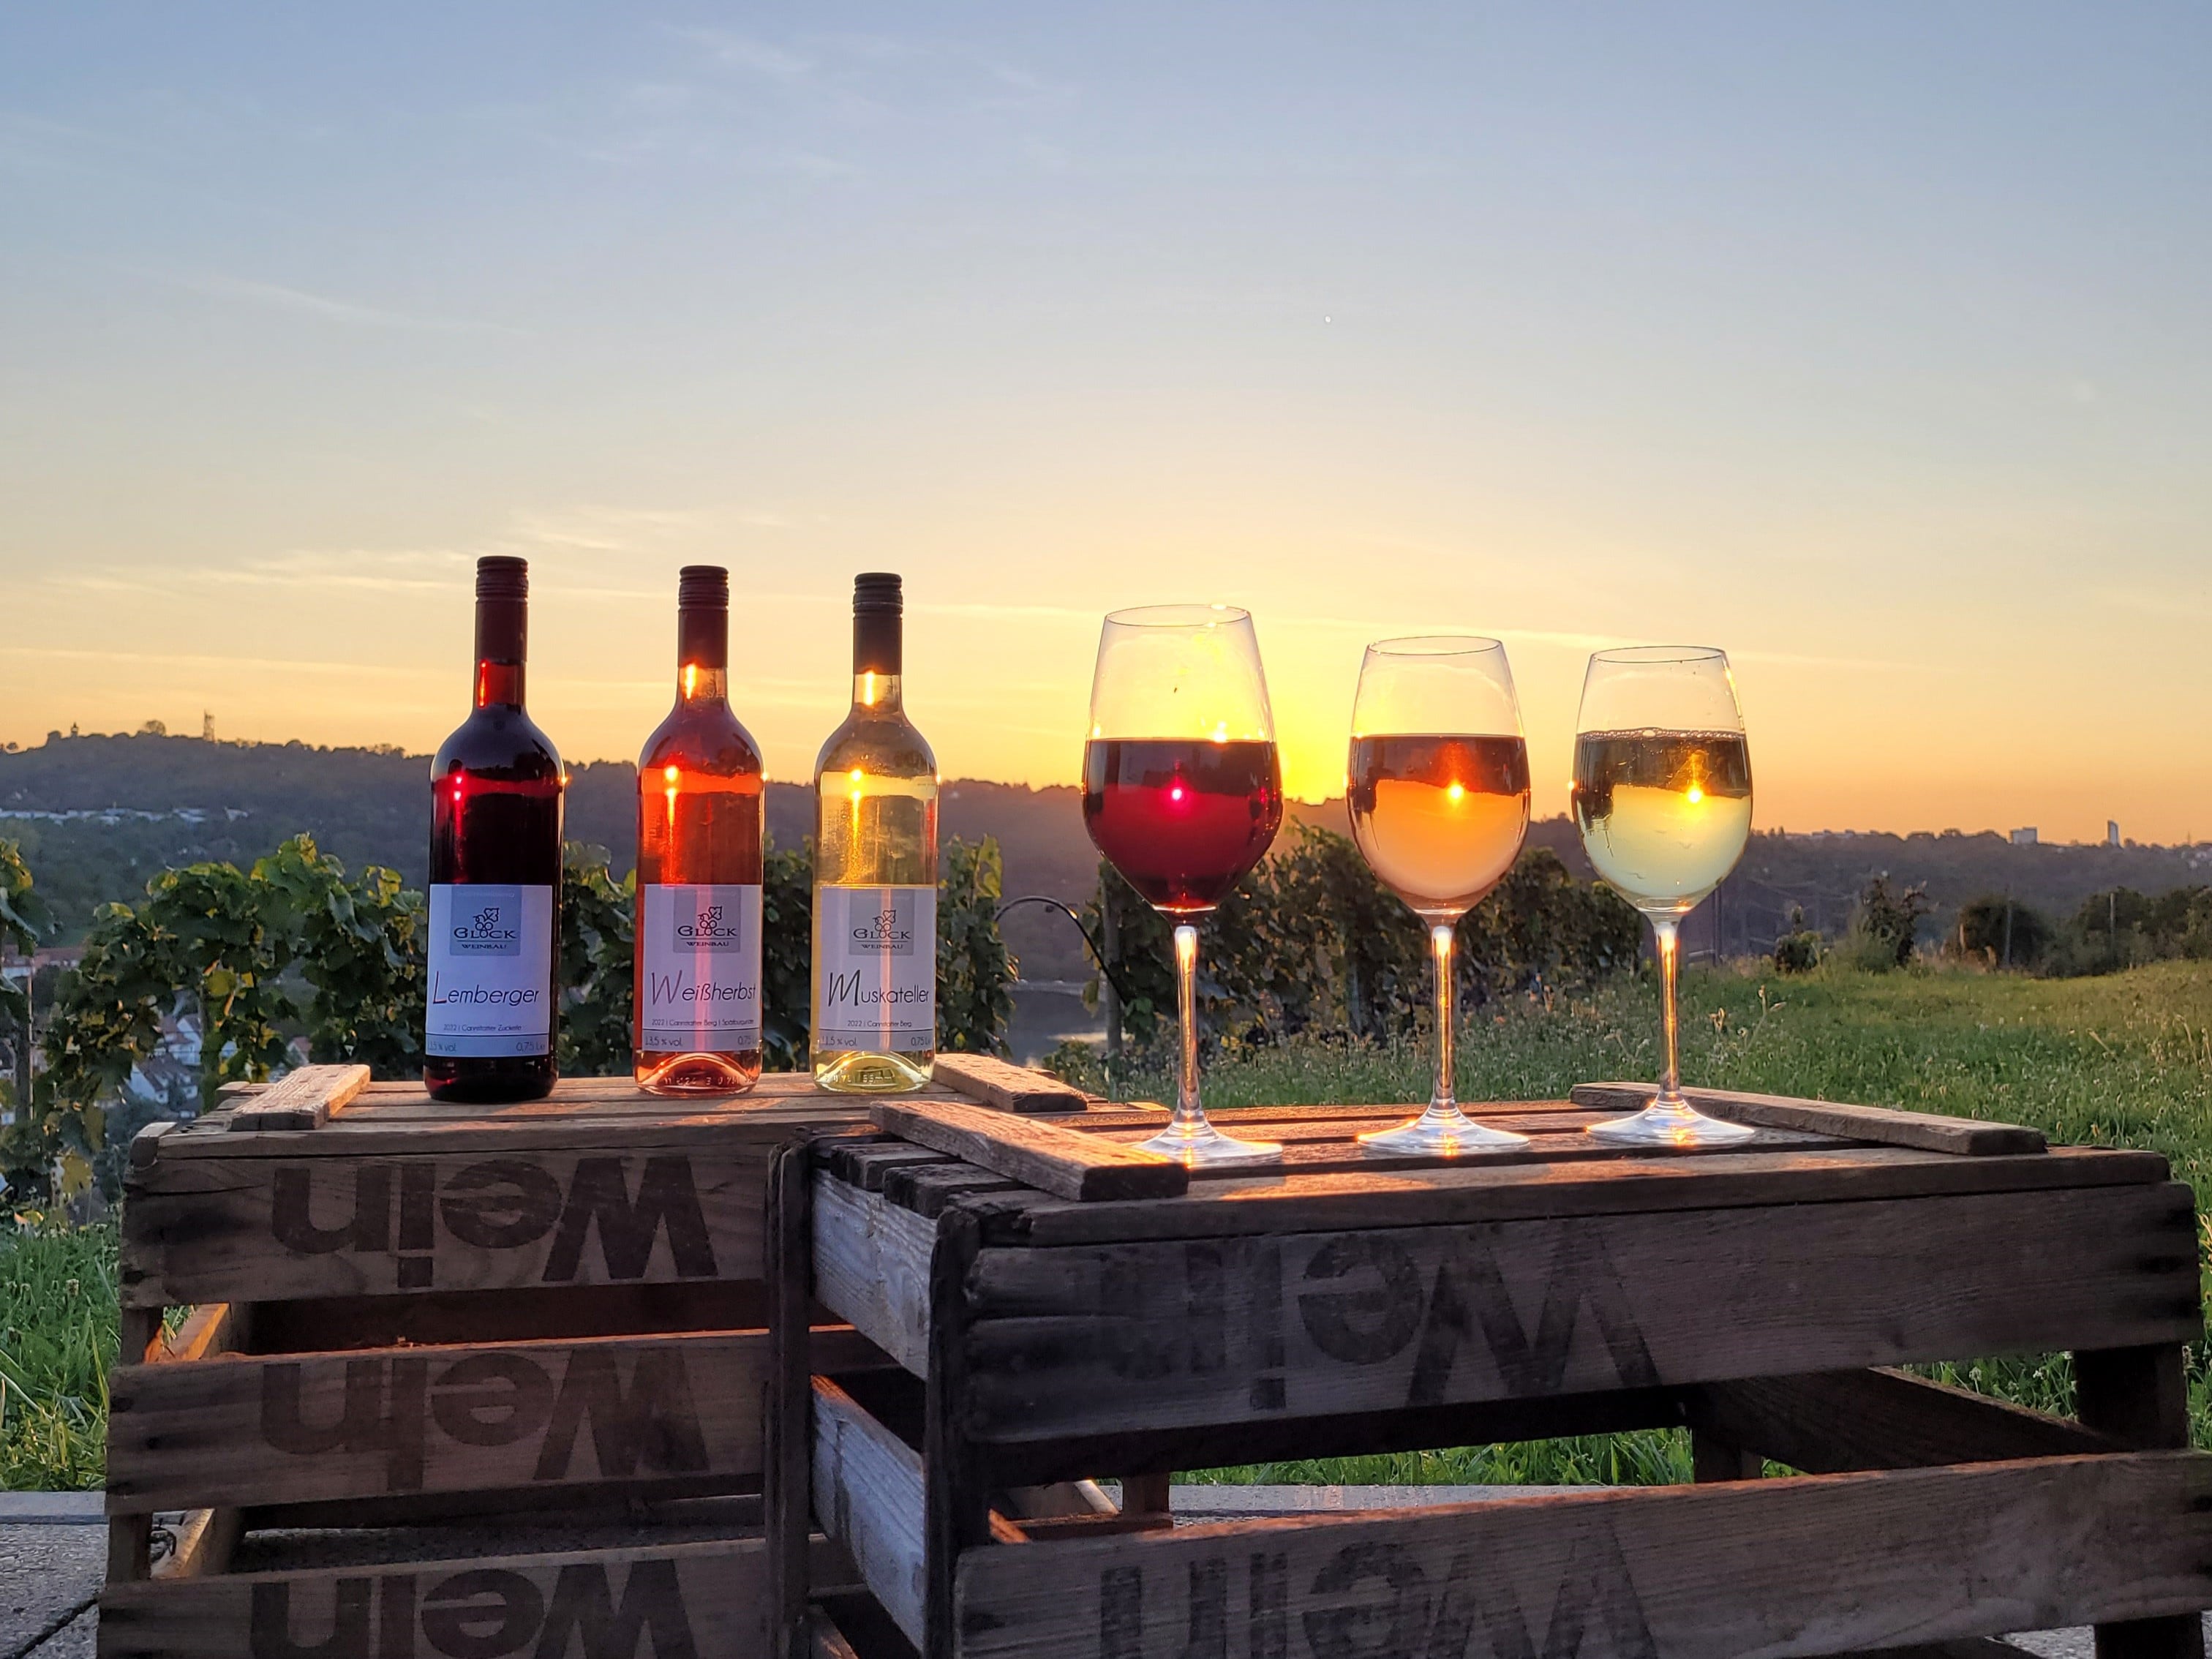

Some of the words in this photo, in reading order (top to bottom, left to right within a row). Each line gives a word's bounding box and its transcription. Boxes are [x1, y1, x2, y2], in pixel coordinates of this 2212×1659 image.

[433, 971, 540, 1007] Lemberger
[651, 969, 756, 1006] Weißherbst
[828, 968, 930, 1007] Muskateller
[271, 1156, 719, 1288] Wein
[1099, 1217, 1663, 1410] Wein
[260, 1345, 710, 1492] Wein
[249, 1558, 700, 1659] Wein
